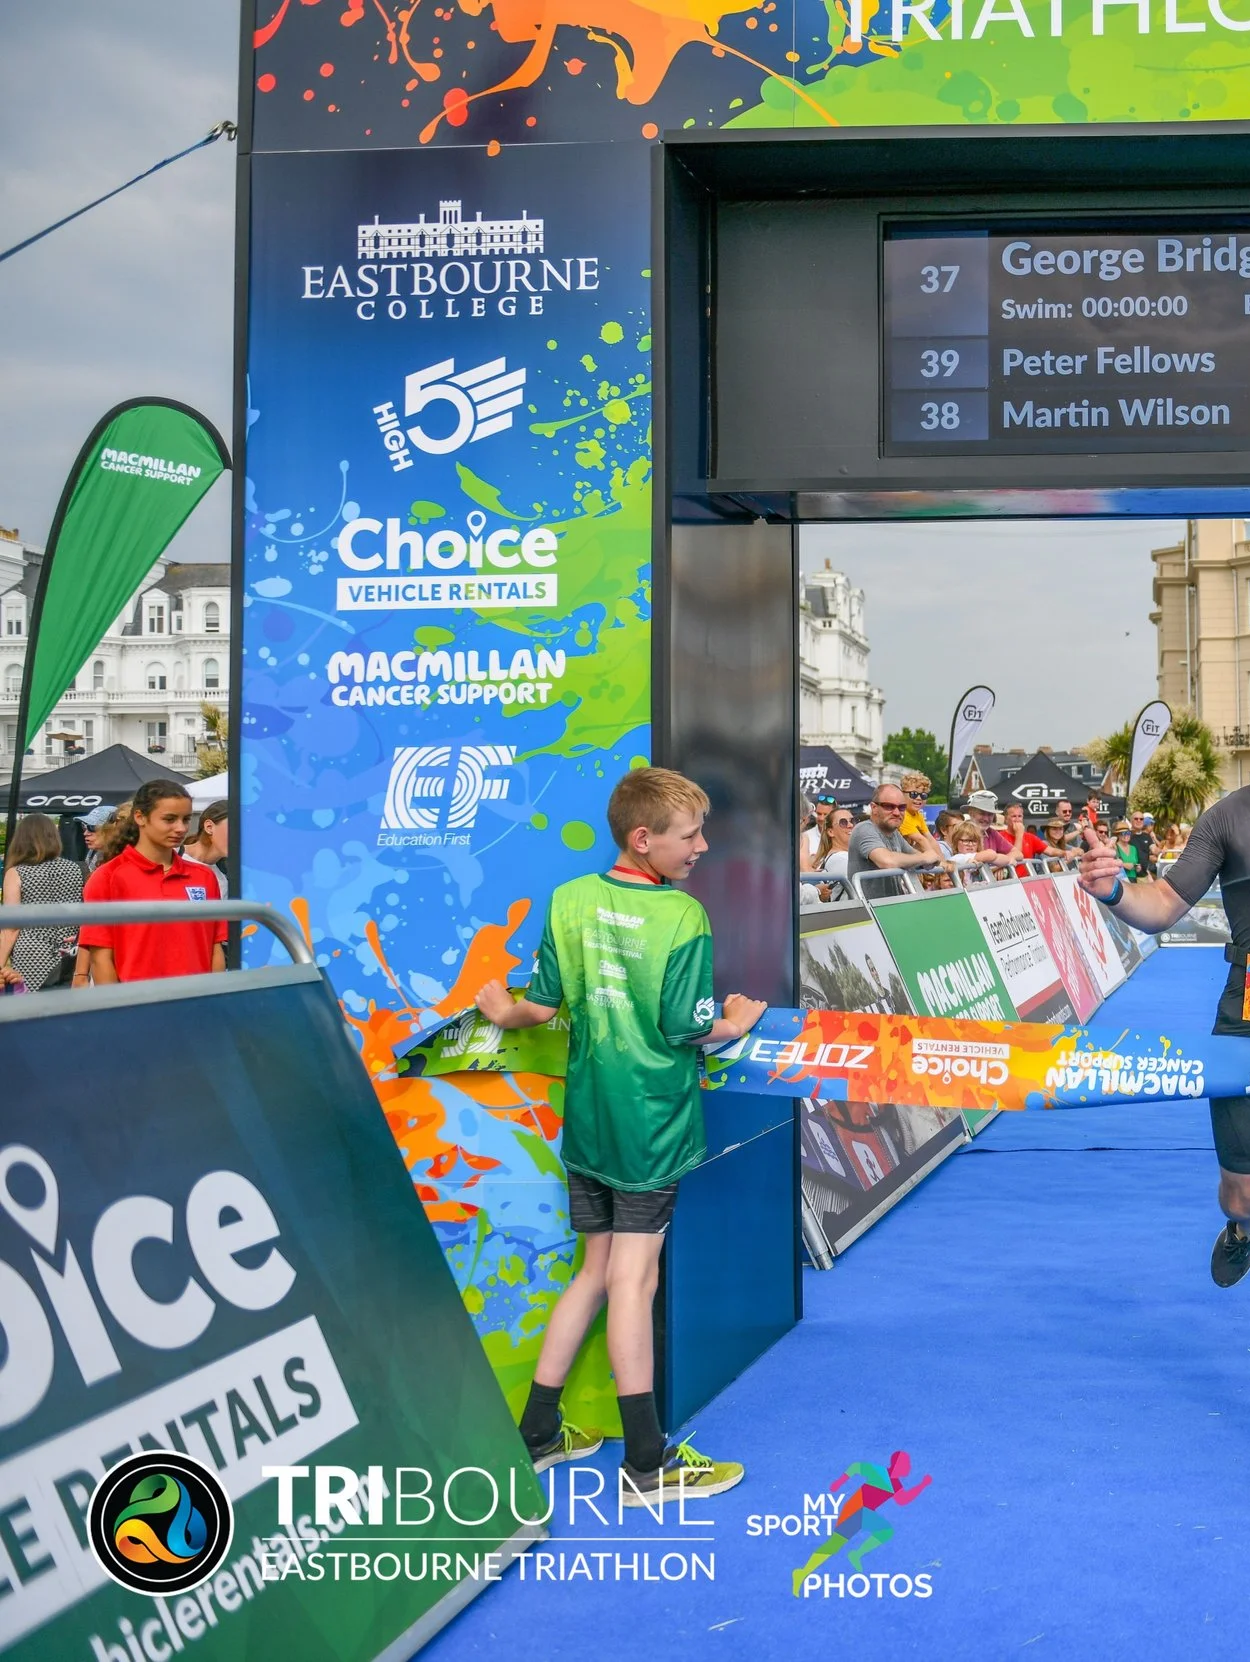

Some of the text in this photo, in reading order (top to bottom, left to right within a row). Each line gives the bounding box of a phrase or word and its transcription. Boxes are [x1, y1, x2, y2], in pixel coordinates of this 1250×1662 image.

[1001, 242, 1145, 281] George
[302, 257, 599, 299] EASTBOURNE
[920, 266, 960, 293] 37
[357, 296, 544, 320] COLLEGE
[1001, 296, 1188, 319] Swim: 00:00:00
[920, 350, 960, 377] 39
[1003, 346, 1215, 376] Peter Fellows
[920, 402, 960, 430] 38
[1003, 398, 1230, 428] Martin Wilson
[372, 401, 414, 472] HIGH
[101, 448, 201, 478] MACMILLAN
[101, 461, 193, 486] CANCER SUPPORT
[337, 511, 557, 571] Choice
[348, 581, 546, 602] VEHICLE RENTALS
[328, 649, 566, 684] MACMILLAN
[332, 682, 552, 707] CANCER SUPPORT
[26, 795, 102, 806] orca
[377, 832, 472, 847] Education First
[917, 952, 996, 1018] MACMILLAN
[749, 1039, 875, 1069] ZONE3
[918, 1043, 1005, 1055] VEHICLE RENTALS
[1056, 1051, 1203, 1074] CANCER SUPPORT
[912, 1054, 1009, 1085] Choice
[1046, 1066, 1205, 1098] MACMILLAN
[53, 1356, 322, 1551] RTALS
